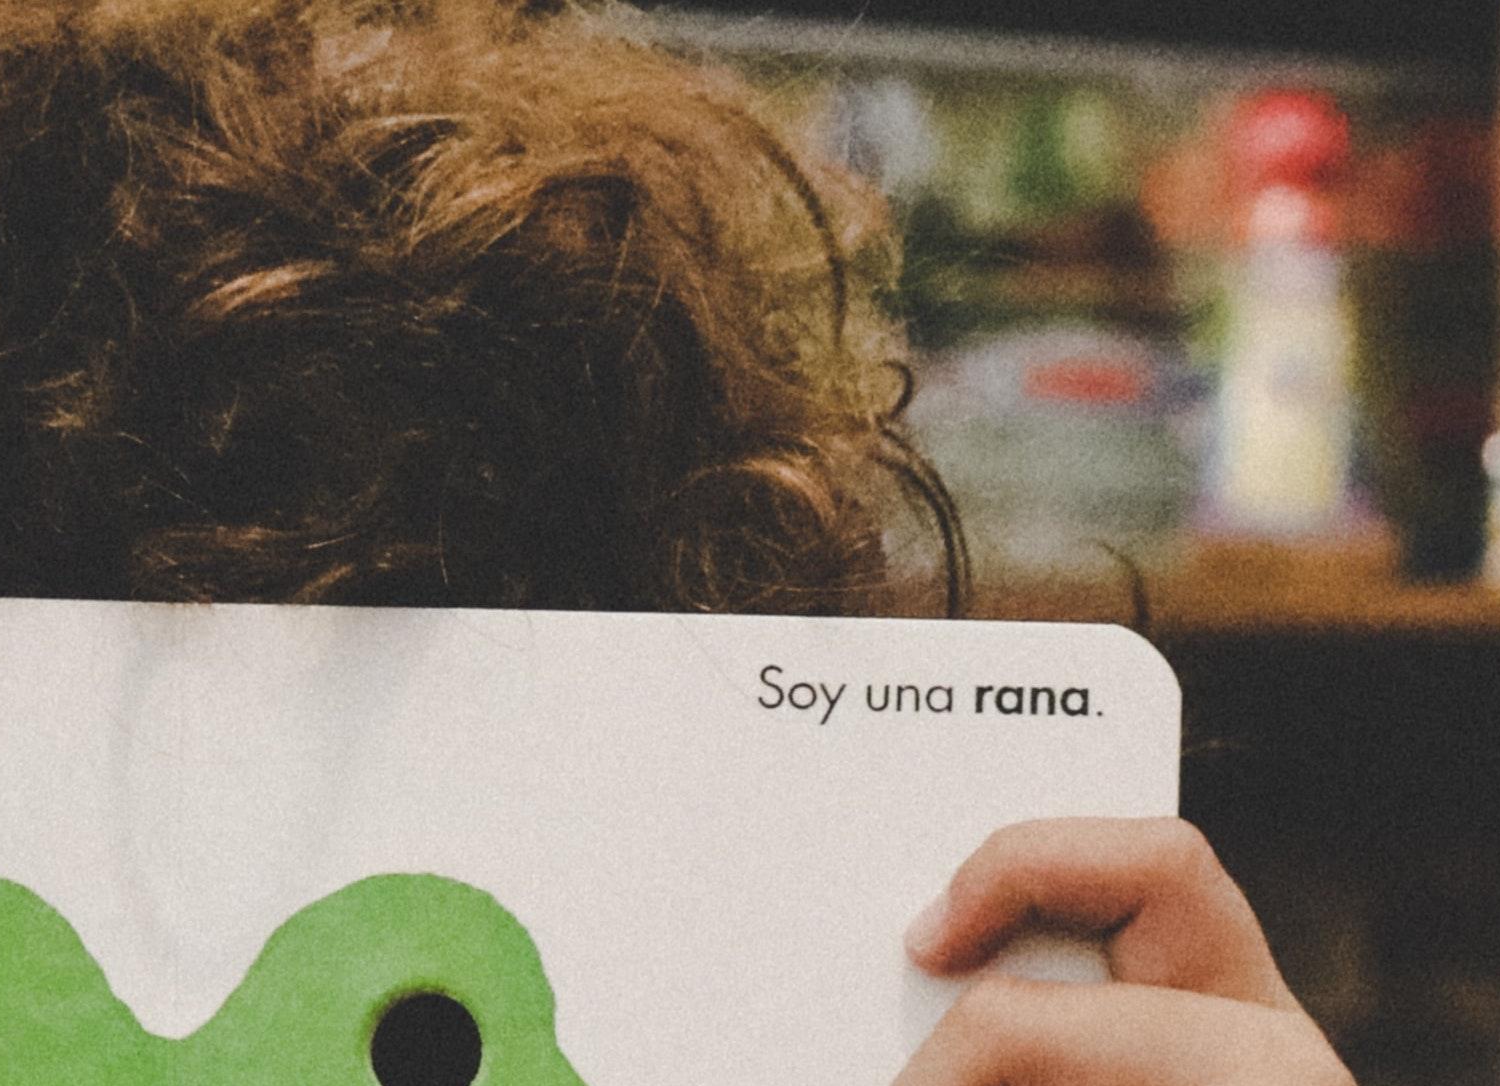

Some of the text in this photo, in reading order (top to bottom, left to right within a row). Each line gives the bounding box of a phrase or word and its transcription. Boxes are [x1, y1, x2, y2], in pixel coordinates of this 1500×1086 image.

[758, 664, 1103, 725] Soy una rana.
